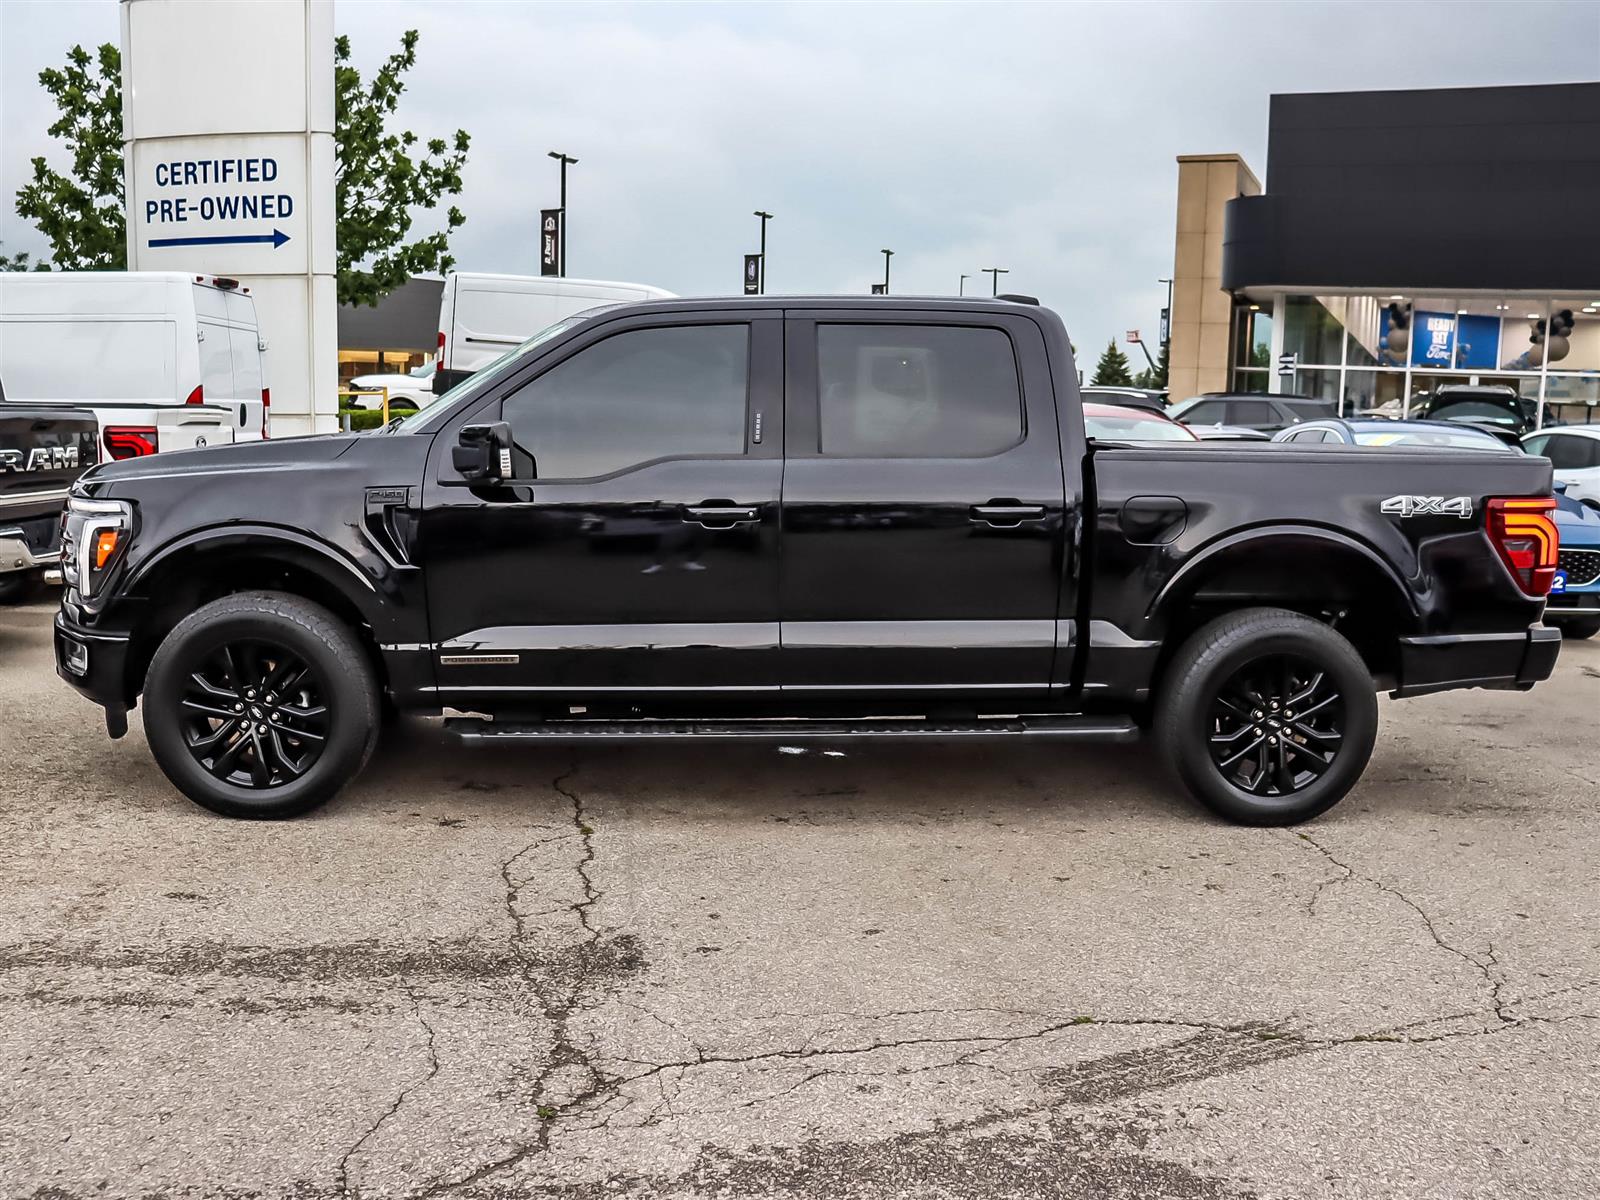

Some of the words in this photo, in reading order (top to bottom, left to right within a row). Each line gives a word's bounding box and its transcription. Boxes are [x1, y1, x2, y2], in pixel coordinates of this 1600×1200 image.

[155, 158, 278, 187] CERTIFIED
[146, 194, 294, 224] PRE-OWNED
[1427, 318, 1455, 332] READY
[0, 446, 79, 473] RAM
